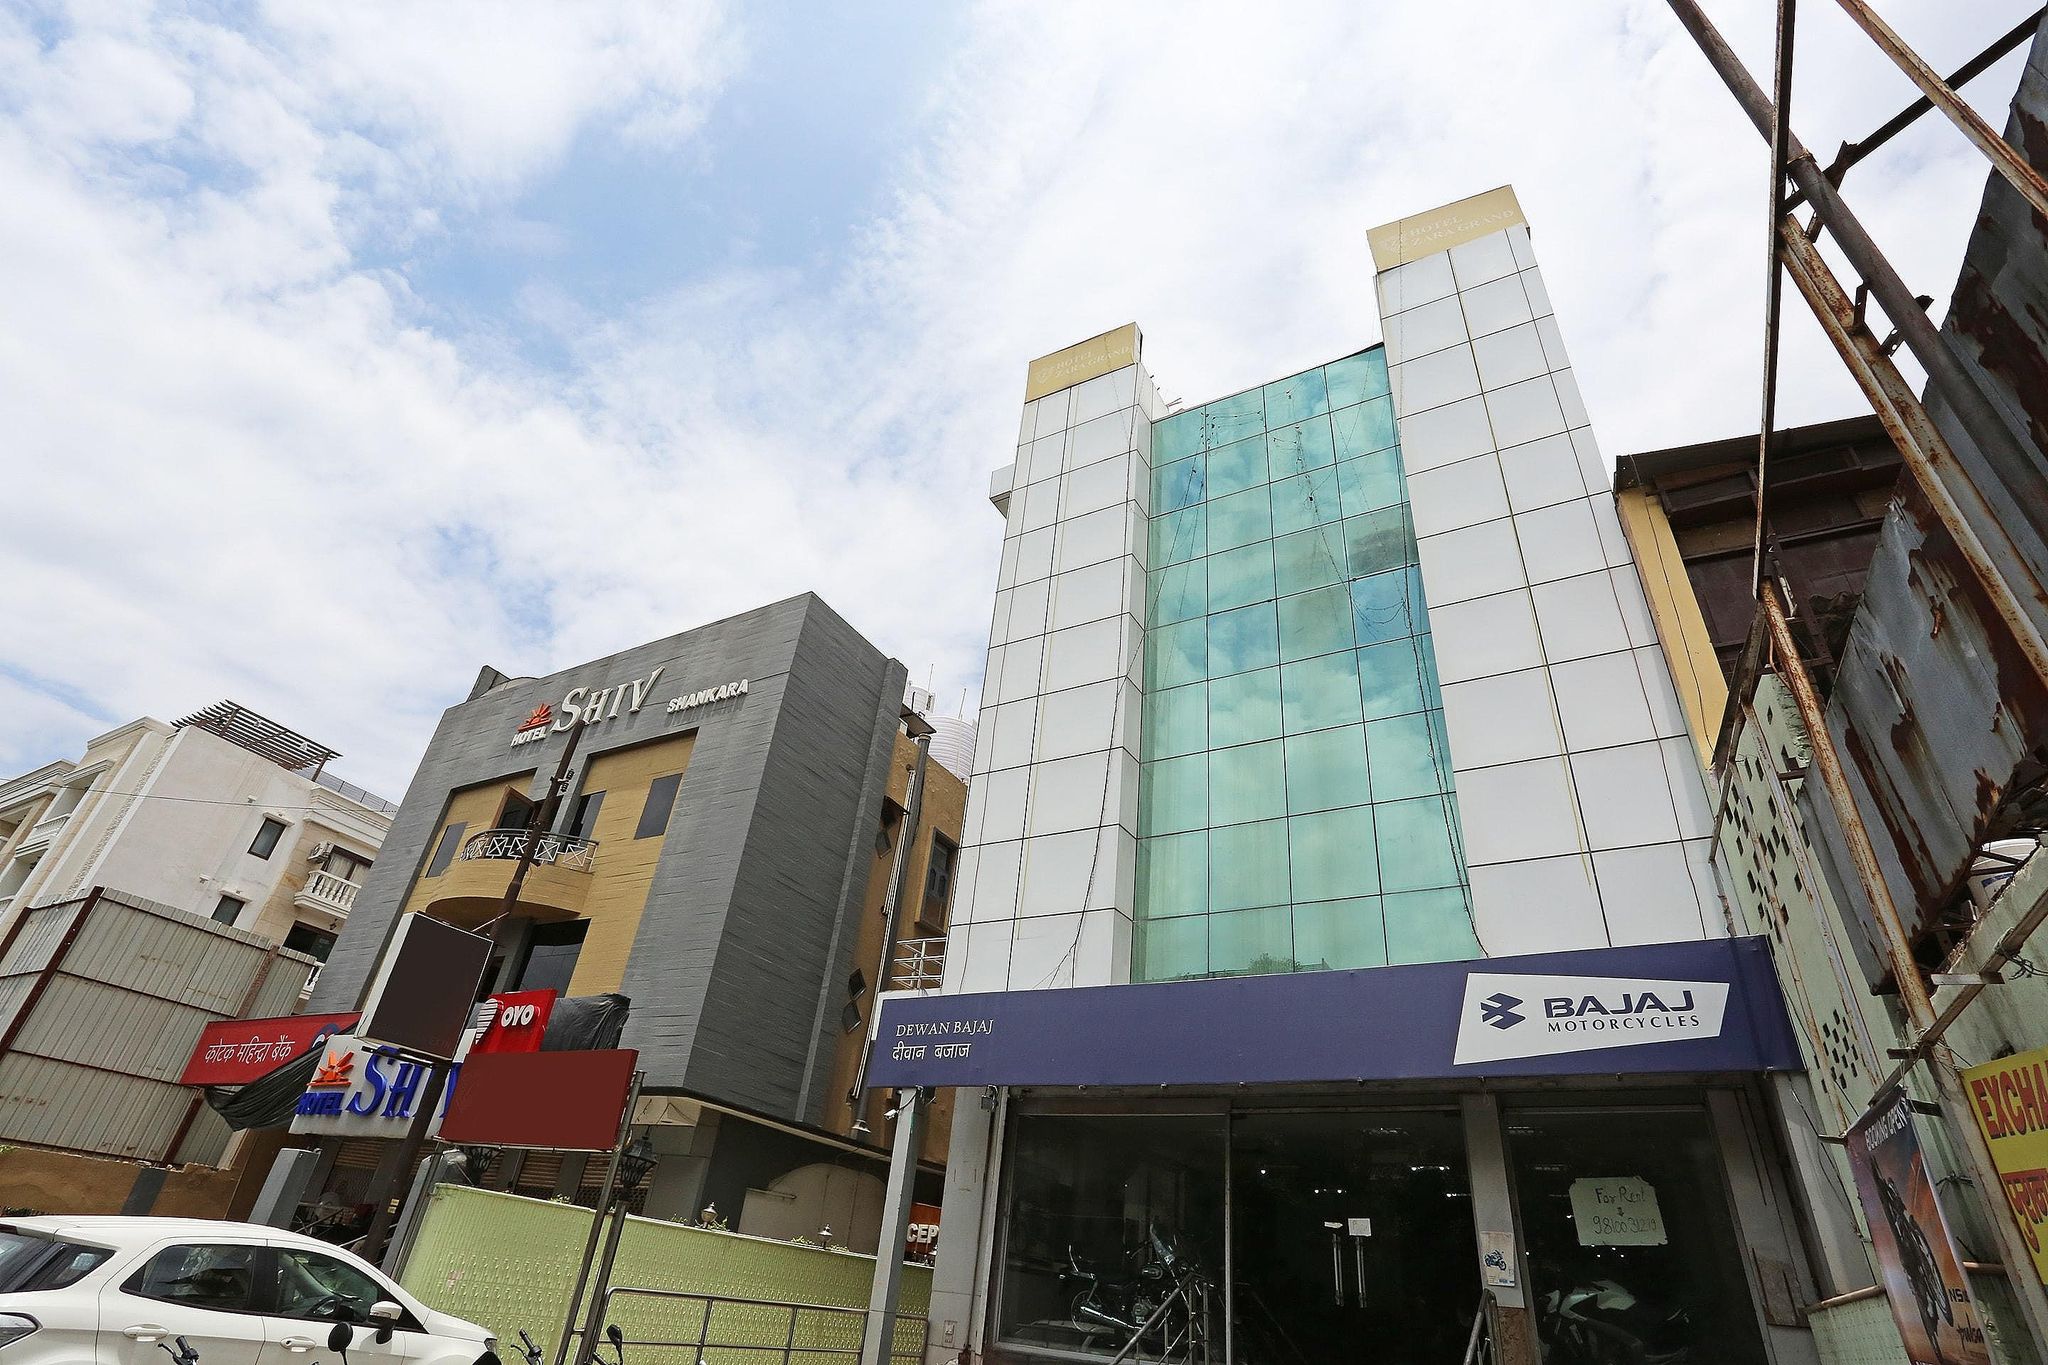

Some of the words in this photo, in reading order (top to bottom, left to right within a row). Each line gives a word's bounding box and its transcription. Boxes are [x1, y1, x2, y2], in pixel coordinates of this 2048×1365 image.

[510, 726, 547, 747] HOTEL
[551, 665, 665, 733] SHIV
[666, 679, 749, 714] SHANKARA
[501, 1004, 535, 1027] OYO
[1543, 990, 1695, 1019] BAJAJ
[895, 1022, 951, 1037] DEWAN
[952, 1019, 994, 1036] BAJAJ
[1547, 1015, 1700, 1033] MOTORCYCLES
[204, 1037, 239, 1064] कोटक
[271, 1034, 296, 1062] बैंक
[892, 1041, 927, 1060] दीवान
[934, 1043, 972, 1059] बजाज
[1970, 1060, 2048, 1140] EXCHA
